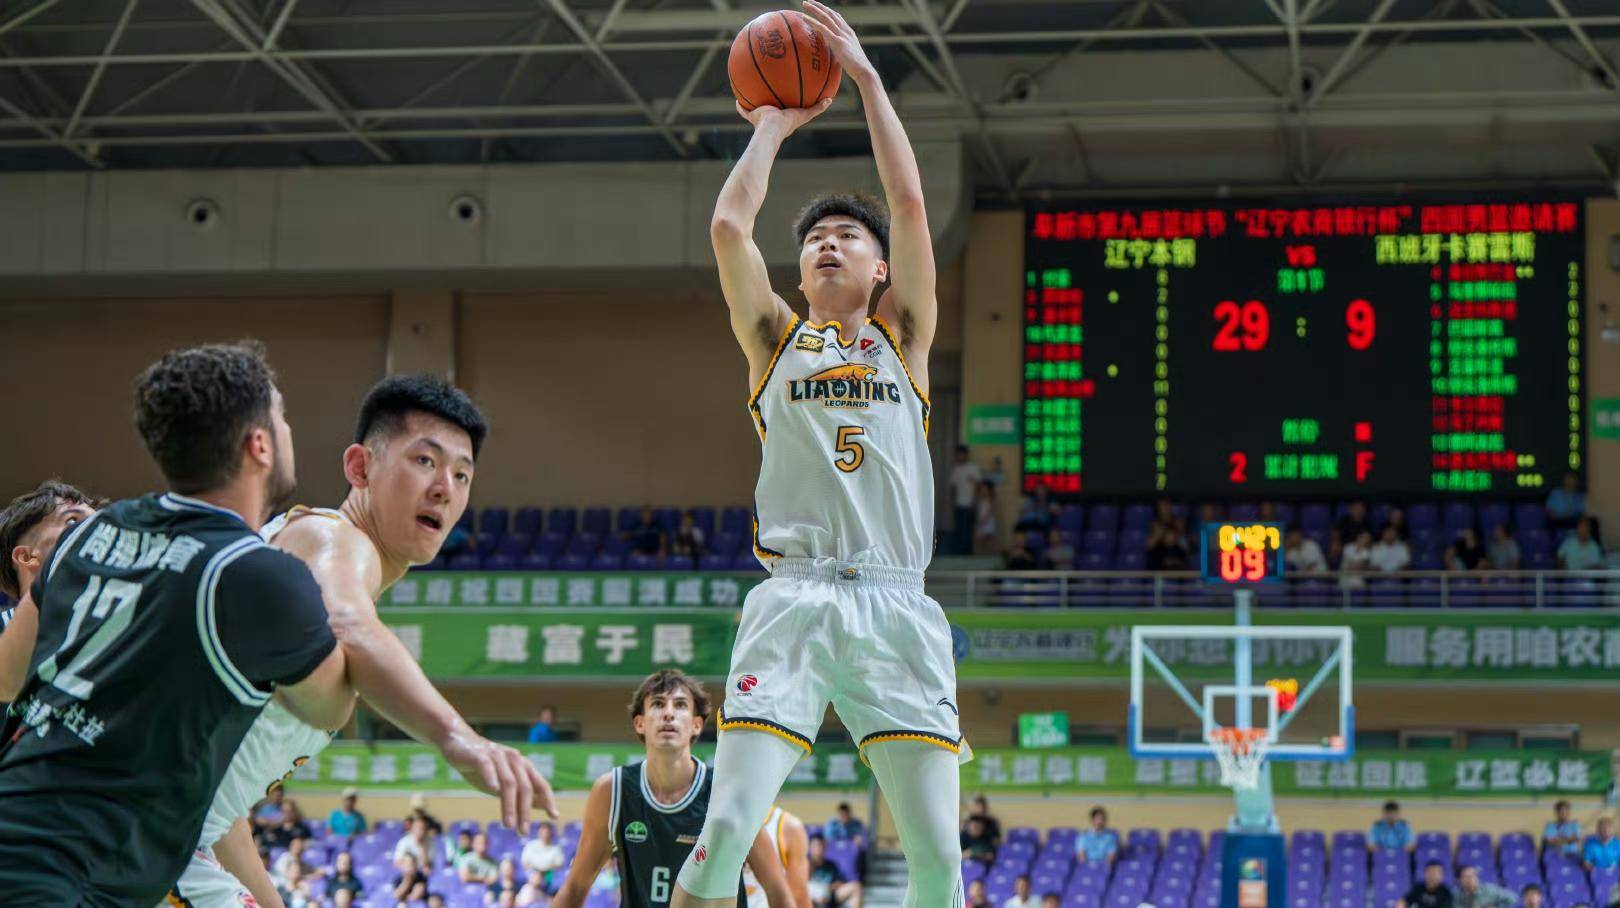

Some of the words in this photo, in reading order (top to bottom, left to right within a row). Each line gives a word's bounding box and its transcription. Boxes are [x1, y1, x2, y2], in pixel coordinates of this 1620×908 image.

[1105, 238, 1197, 268] 辽宁本钢
[1213, 301, 1269, 350] 29
[1346, 300, 1375, 349] 9
[788, 378, 902, 404] LIAONING
[824, 400, 869, 408] LEOPARDS
[834, 425, 865, 473] 5
[1356, 452, 1373, 480] F
[1230, 452, 1246, 482] 2
[1221, 547, 1266, 581] 09
[37, 574, 143, 701] 17
[650, 866, 671, 903] 6
